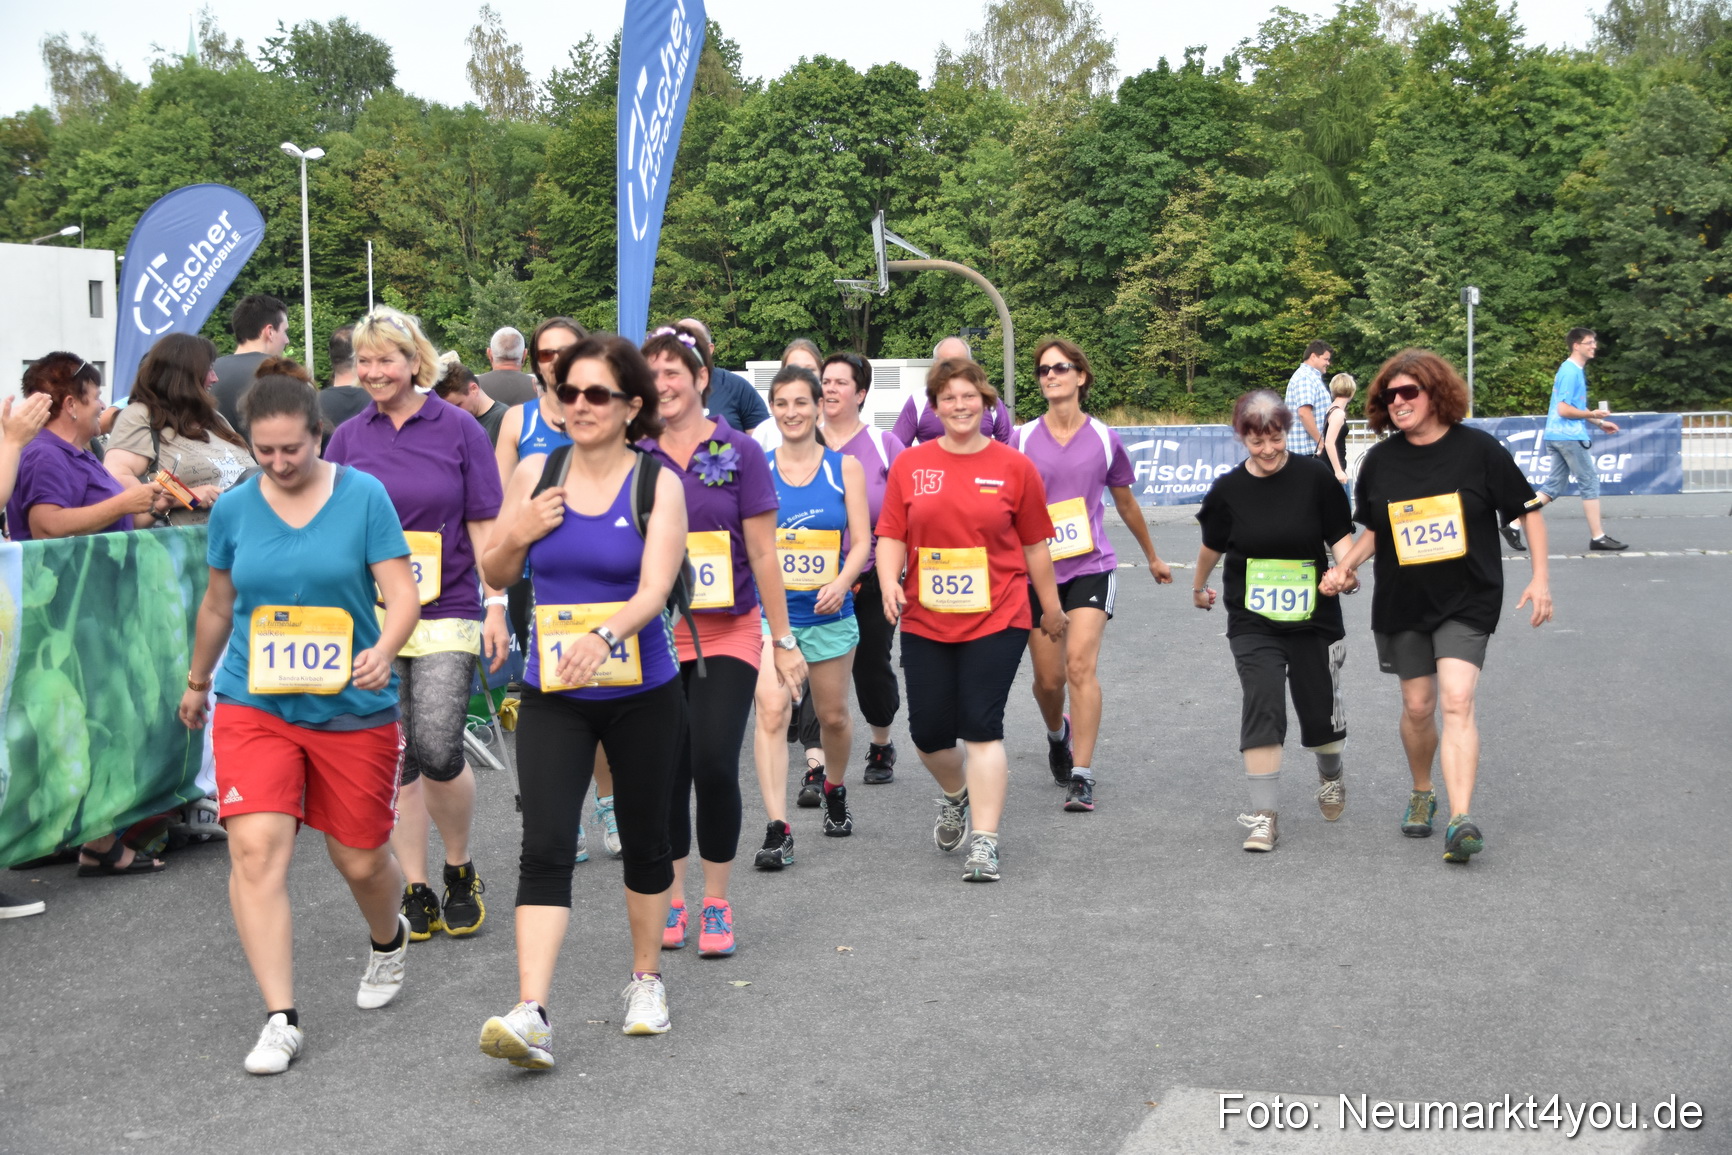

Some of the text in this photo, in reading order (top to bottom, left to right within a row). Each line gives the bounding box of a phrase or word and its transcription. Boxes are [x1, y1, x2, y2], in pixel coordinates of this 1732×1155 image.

[651, 23, 692, 200] AUTOMOBILE
[152, 210, 232, 317] Fischer
[181, 230, 241, 316] AUTOMOBILE
[1134, 459, 1240, 481] Fische
[1514, 450, 1632, 472] Fiser
[912, 469, 944, 496] 13
[787, 511, 808, 523] Schick
[1401, 520, 1457, 546] 1254
[783, 554, 825, 574] 839
[932, 575, 974, 595] 852
[1249, 588, 1309, 611] 5191
[263, 641, 341, 670] 1102
[550, 640, 630, 664] 14
[223, 794, 244, 804] adidas
